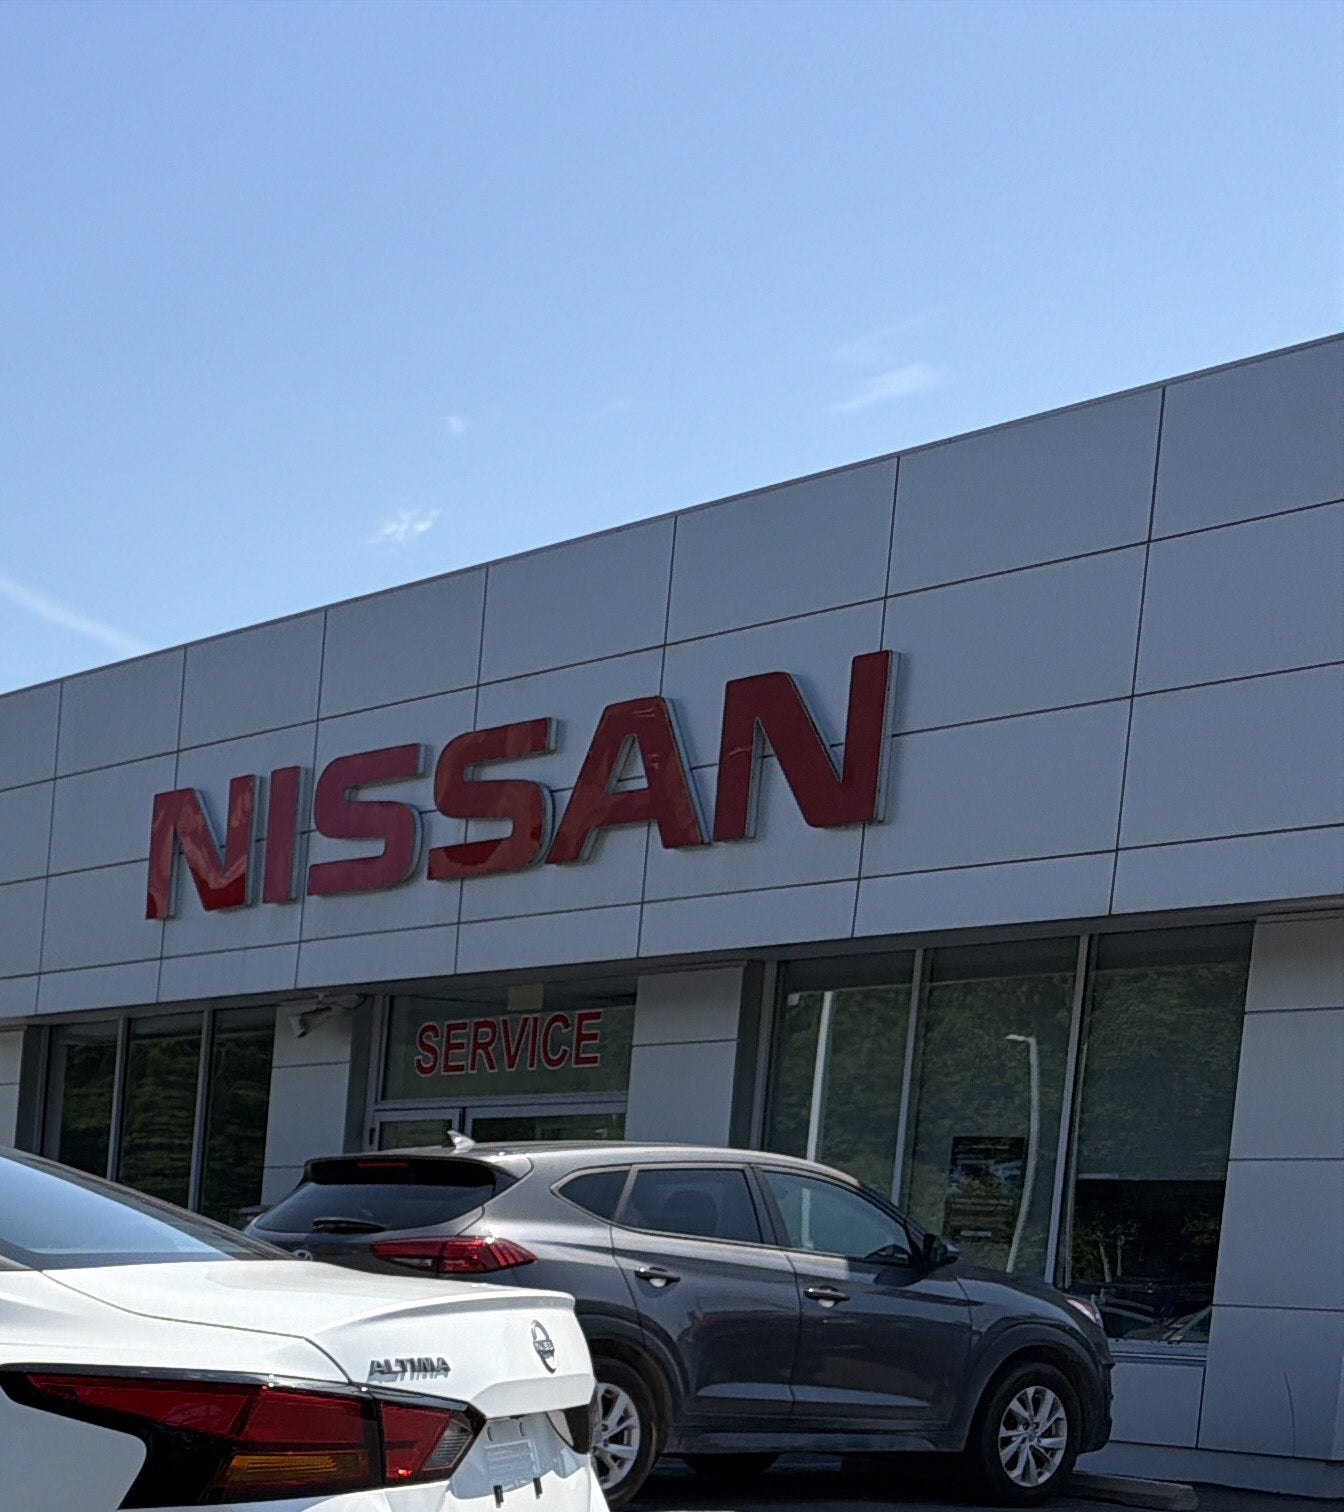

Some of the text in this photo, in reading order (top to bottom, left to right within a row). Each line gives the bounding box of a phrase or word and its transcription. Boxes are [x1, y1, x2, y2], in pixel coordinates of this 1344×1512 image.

[145, 649, 900, 920] NISSAN
[414, 1008, 602, 1077] SERVICE
[369, 1356, 451, 1375] ALTIMA
